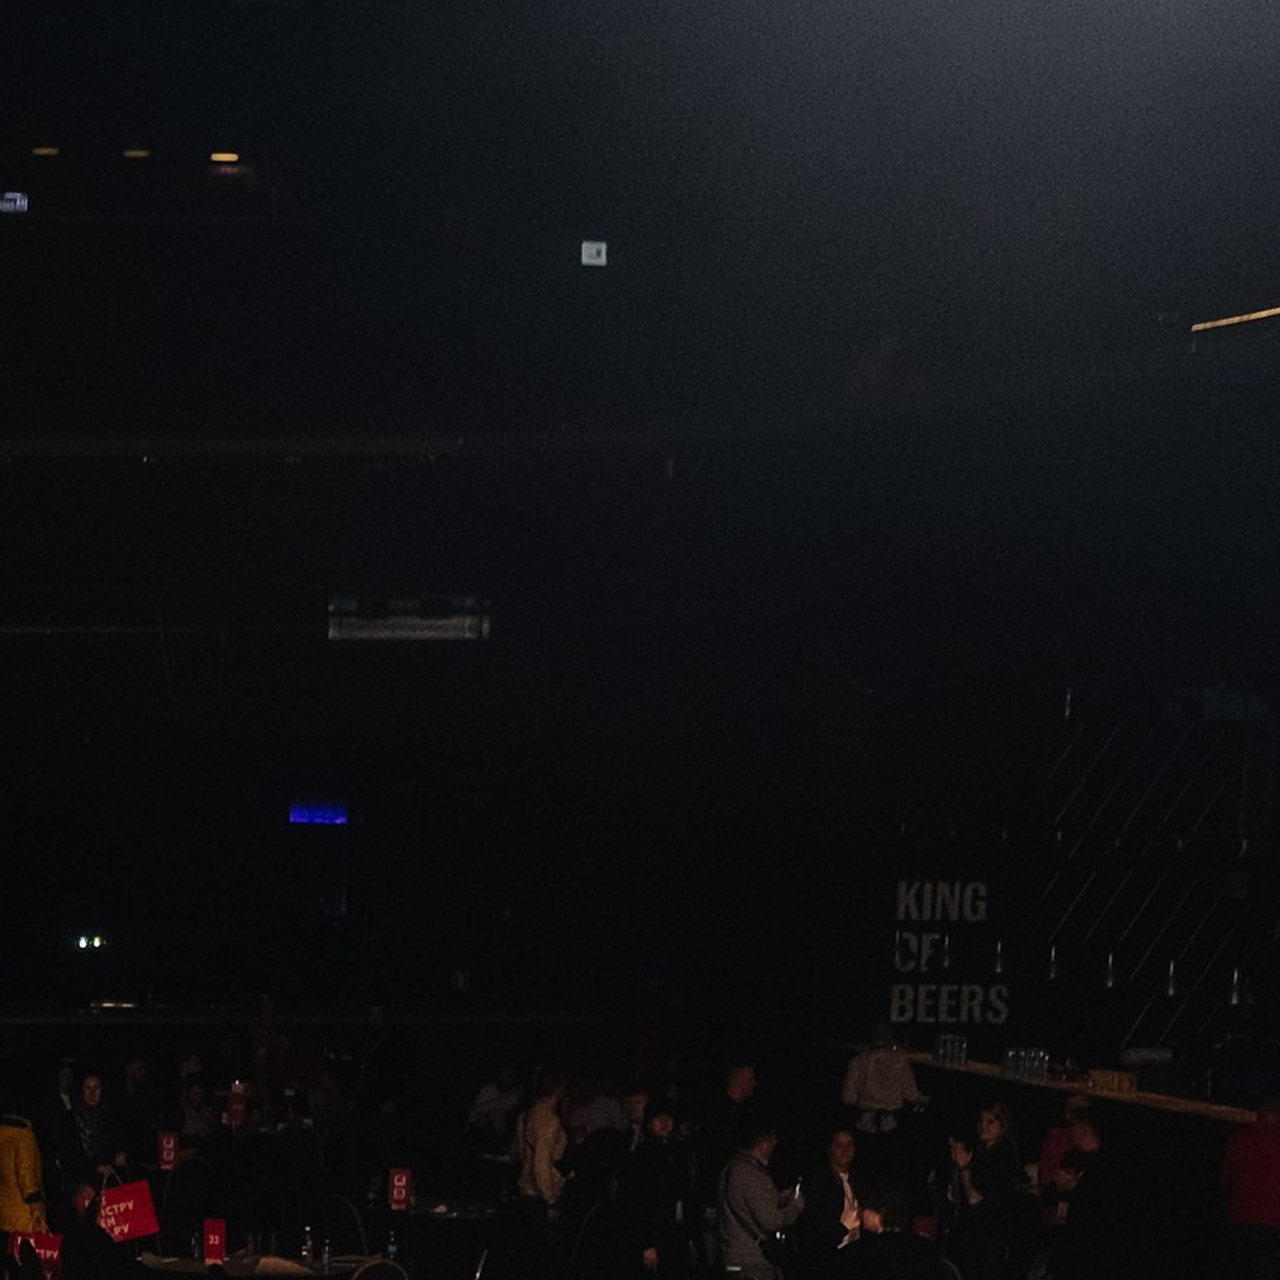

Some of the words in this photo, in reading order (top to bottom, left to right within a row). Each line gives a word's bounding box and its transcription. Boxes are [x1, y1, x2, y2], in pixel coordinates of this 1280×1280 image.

[896, 880, 988, 923] KING
[894, 931, 941, 972] OF
[890, 983, 1010, 1024] BEERS
